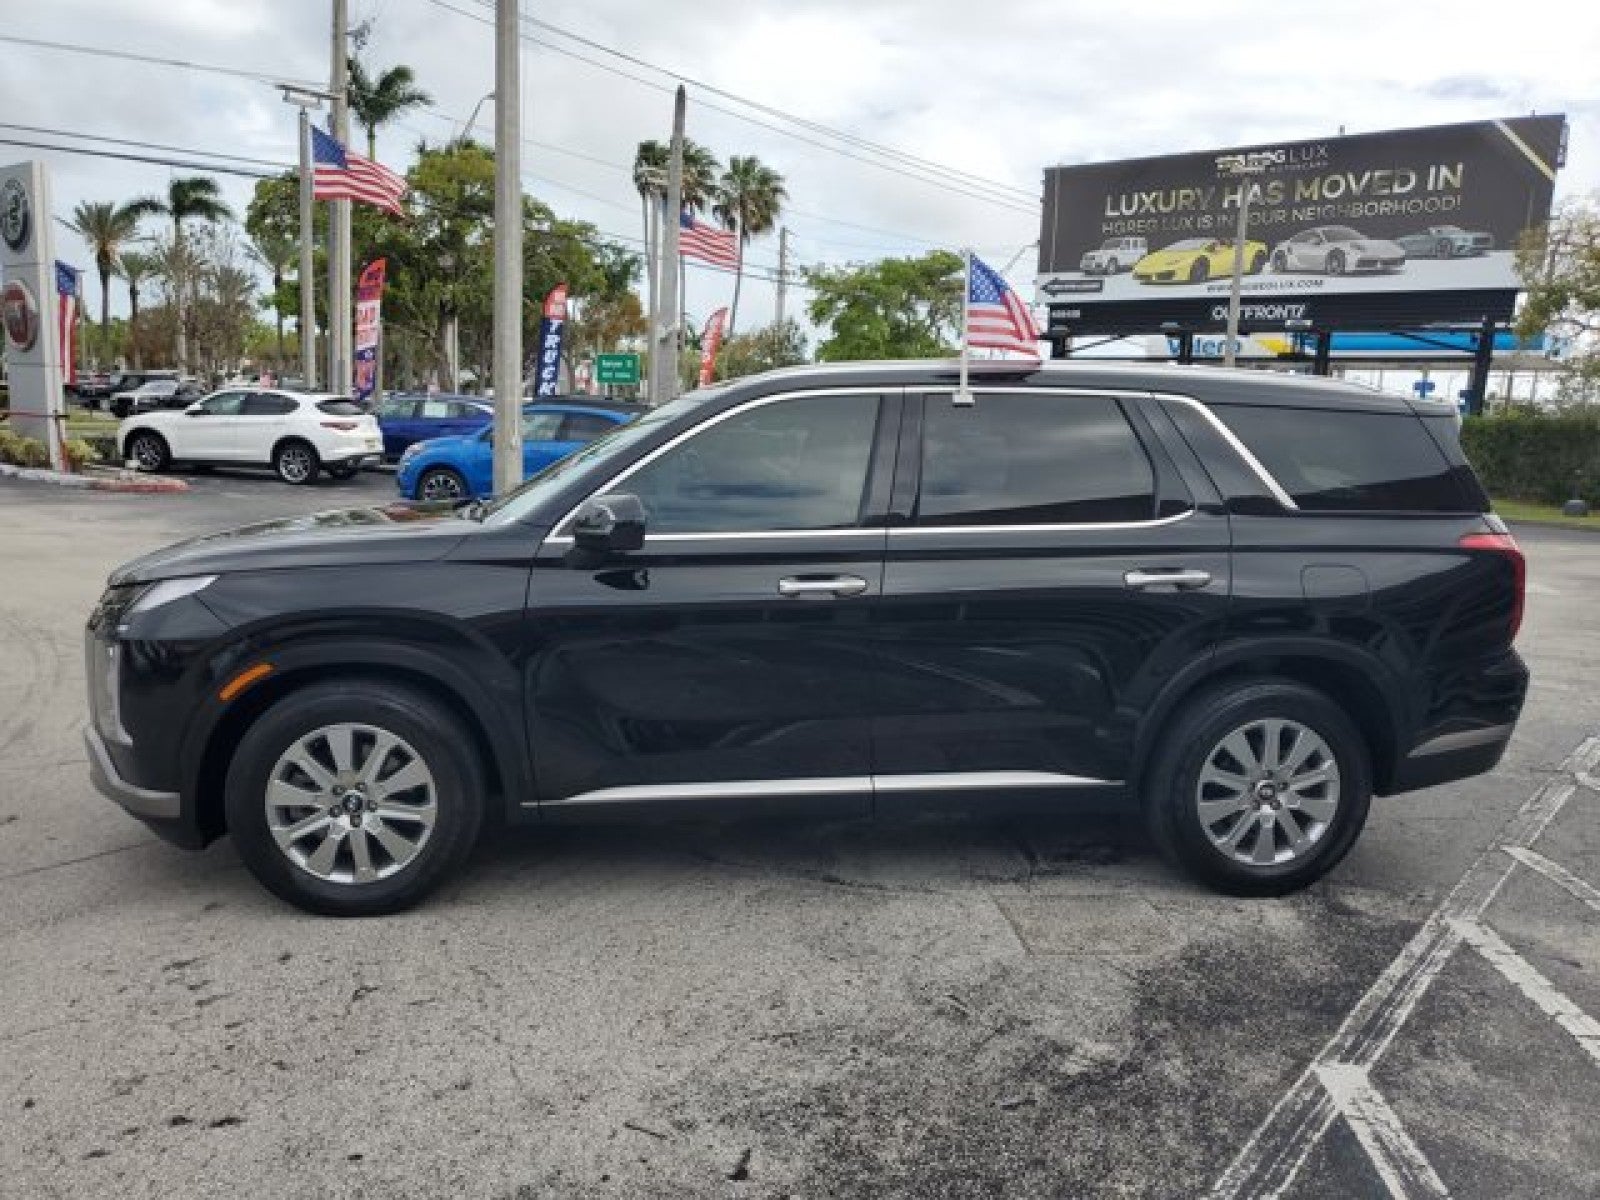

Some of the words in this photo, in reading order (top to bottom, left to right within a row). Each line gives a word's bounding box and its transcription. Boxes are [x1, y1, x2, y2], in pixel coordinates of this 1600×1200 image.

[1104, 186, 1216, 217] LUXURY
[1221, 179, 1286, 209] HAS
[1294, 168, 1416, 202] MOVED
[1426, 161, 1463, 191] IN
[1241, 209, 1287, 226] OUR
[1292, 195, 1461, 221] NEIGHBORHOOD!
[1167, 336, 1241, 358] Vler
